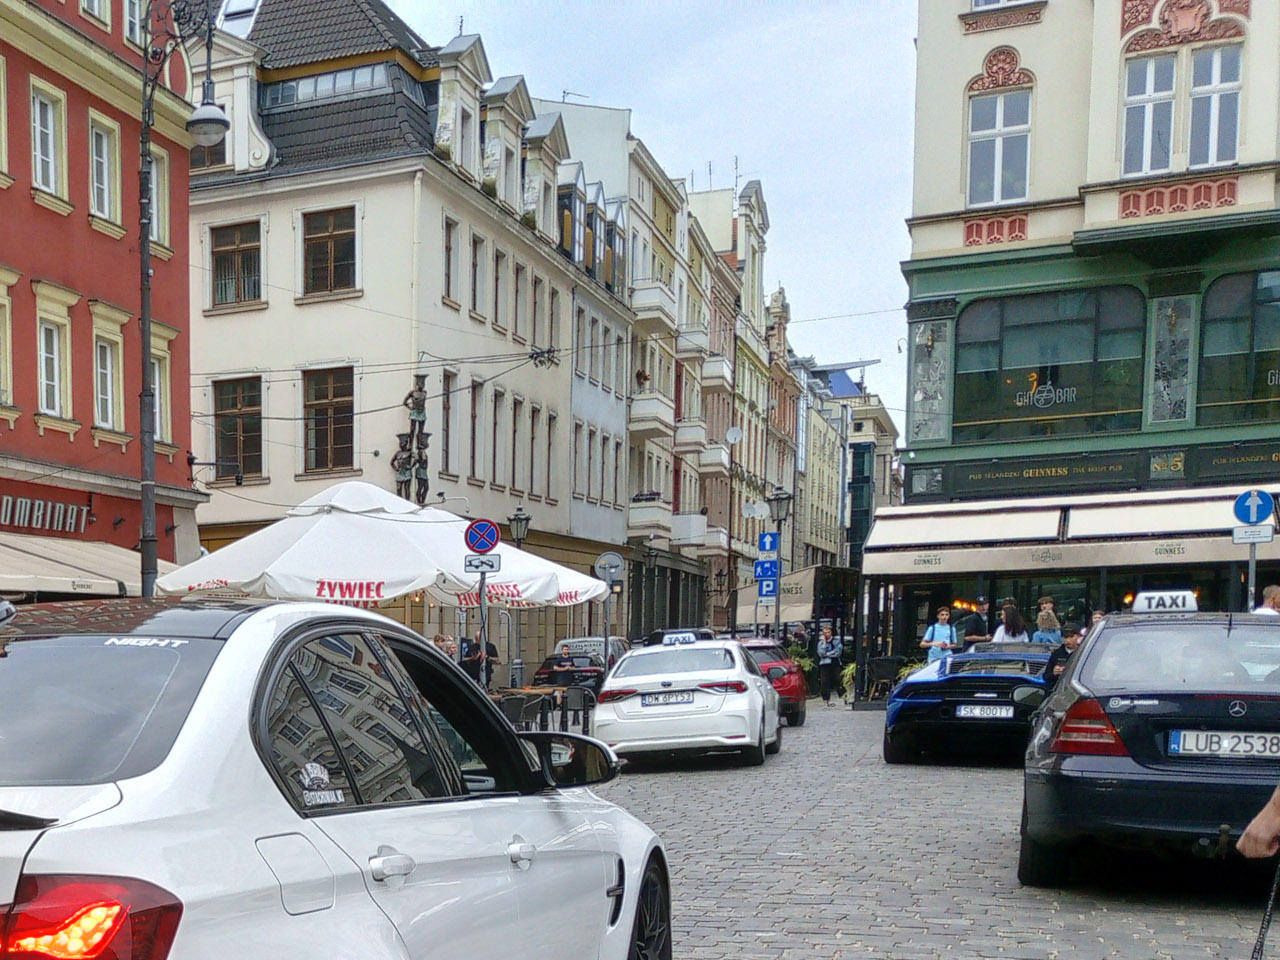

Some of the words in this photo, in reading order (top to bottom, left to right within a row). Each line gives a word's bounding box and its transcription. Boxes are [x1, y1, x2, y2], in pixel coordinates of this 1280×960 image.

[1170, 456, 1183, 472] 5
[1022, 466, 1069, 478] GUINNESS
[1155, 547, 1185, 556] GUINNESS
[316, 579, 385, 599] ŻYWIEC
[762, 580, 774, 595] P
[1145, 595, 1186, 610] TAXI
[104, 637, 190, 648] NIGHT
[667, 635, 691, 644] TAXI
[963, 706, 976, 716] SK
[1182, 733, 1222, 752] LUB
